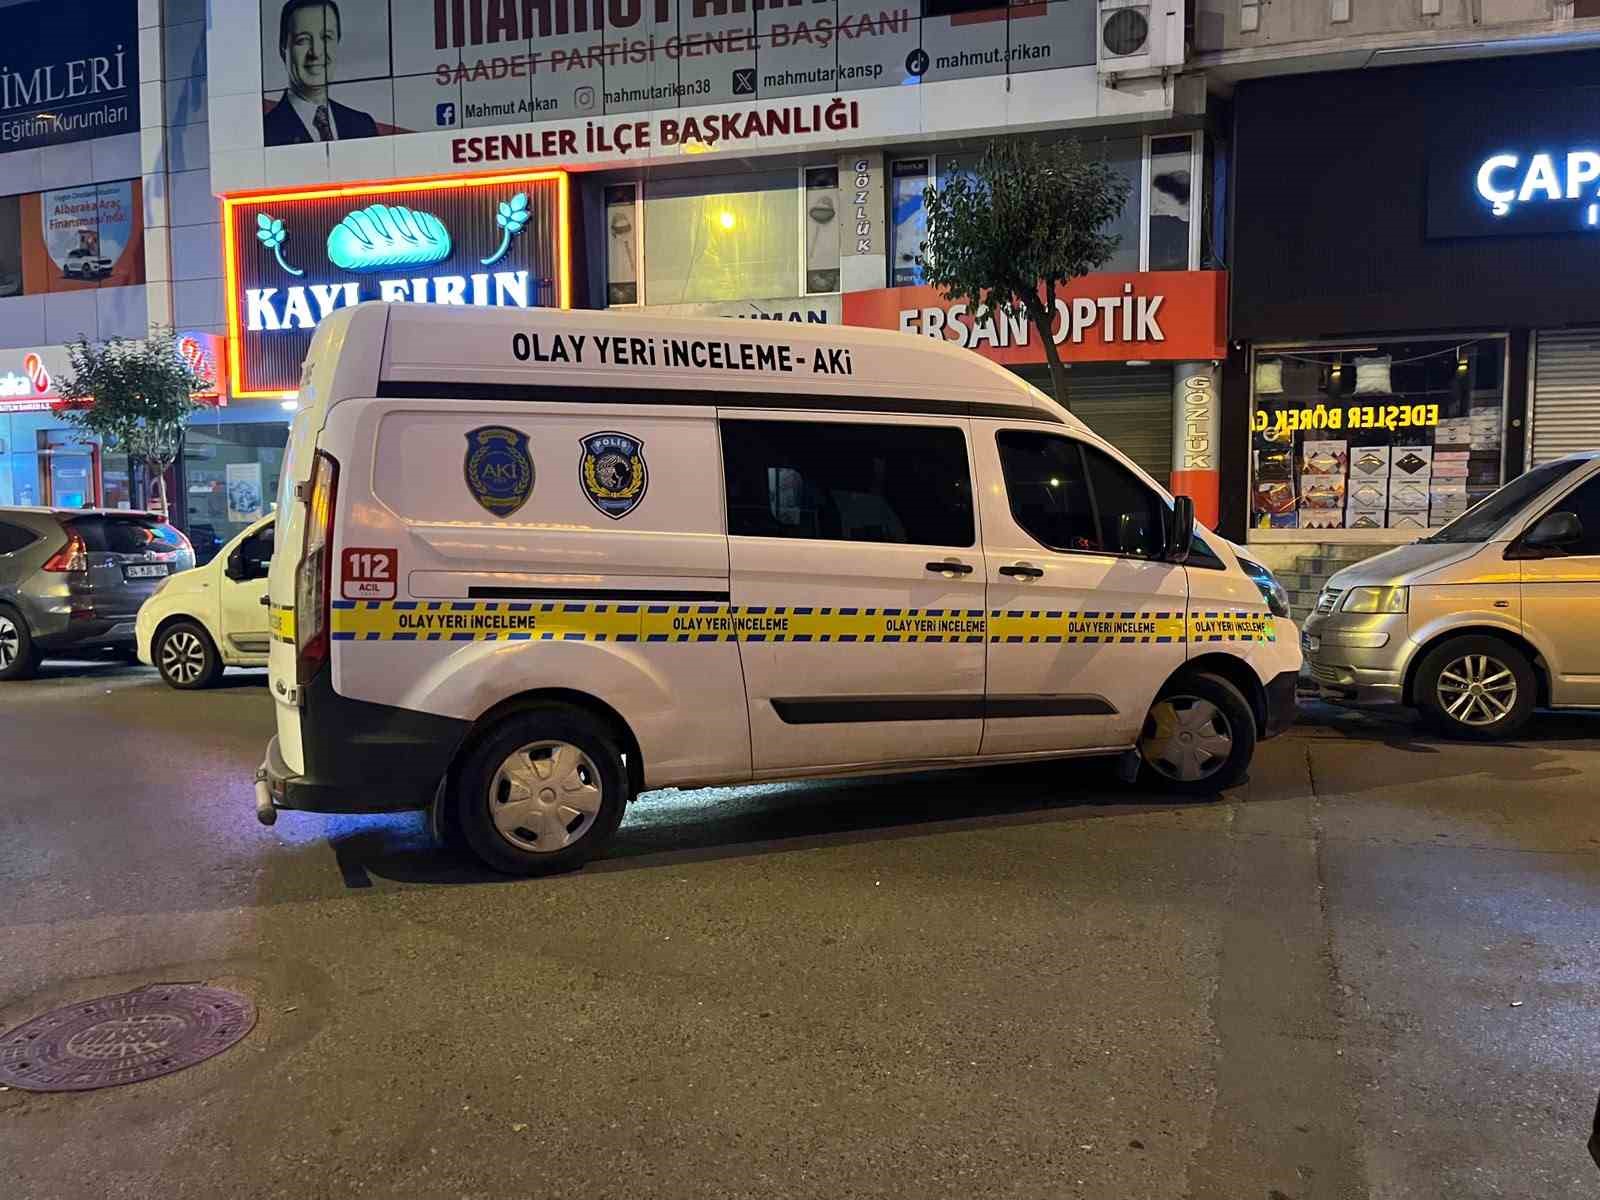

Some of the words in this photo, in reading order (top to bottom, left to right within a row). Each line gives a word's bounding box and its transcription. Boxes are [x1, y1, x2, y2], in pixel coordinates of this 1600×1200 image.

[436, 51, 542, 86] SAADET
[551, 35, 655, 73] PARTİSİ
[664, 27, 760, 60] GENEL
[771, 8, 908, 48] BAŞKANI
[936, 43, 1051, 69] mahmut.arikan
[465, 101, 515, 118] Mahmut
[2, 116, 49, 143] Eğitim
[54, 105, 128, 133] Kurumları
[452, 129, 578, 163] ESENLER
[587, 121, 650, 154] İLÇE
[660, 97, 859, 146] BAŞKANLIĞI
[1476, 151, 1600, 215] ÇAP
[855, 160, 871, 253] GÖZLÜK
[900, 301, 1028, 348] ERSAN
[512, 333, 586, 363] OLAY
[350, 553, 389, 578] 112
[399, 614, 434, 628] OLAY
[673, 617, 702, 631] OLAY
[886, 619, 912, 632] OLAY
[1068, 622, 1091, 633] OLAY
[1195, 622, 1216, 632] OLAY
